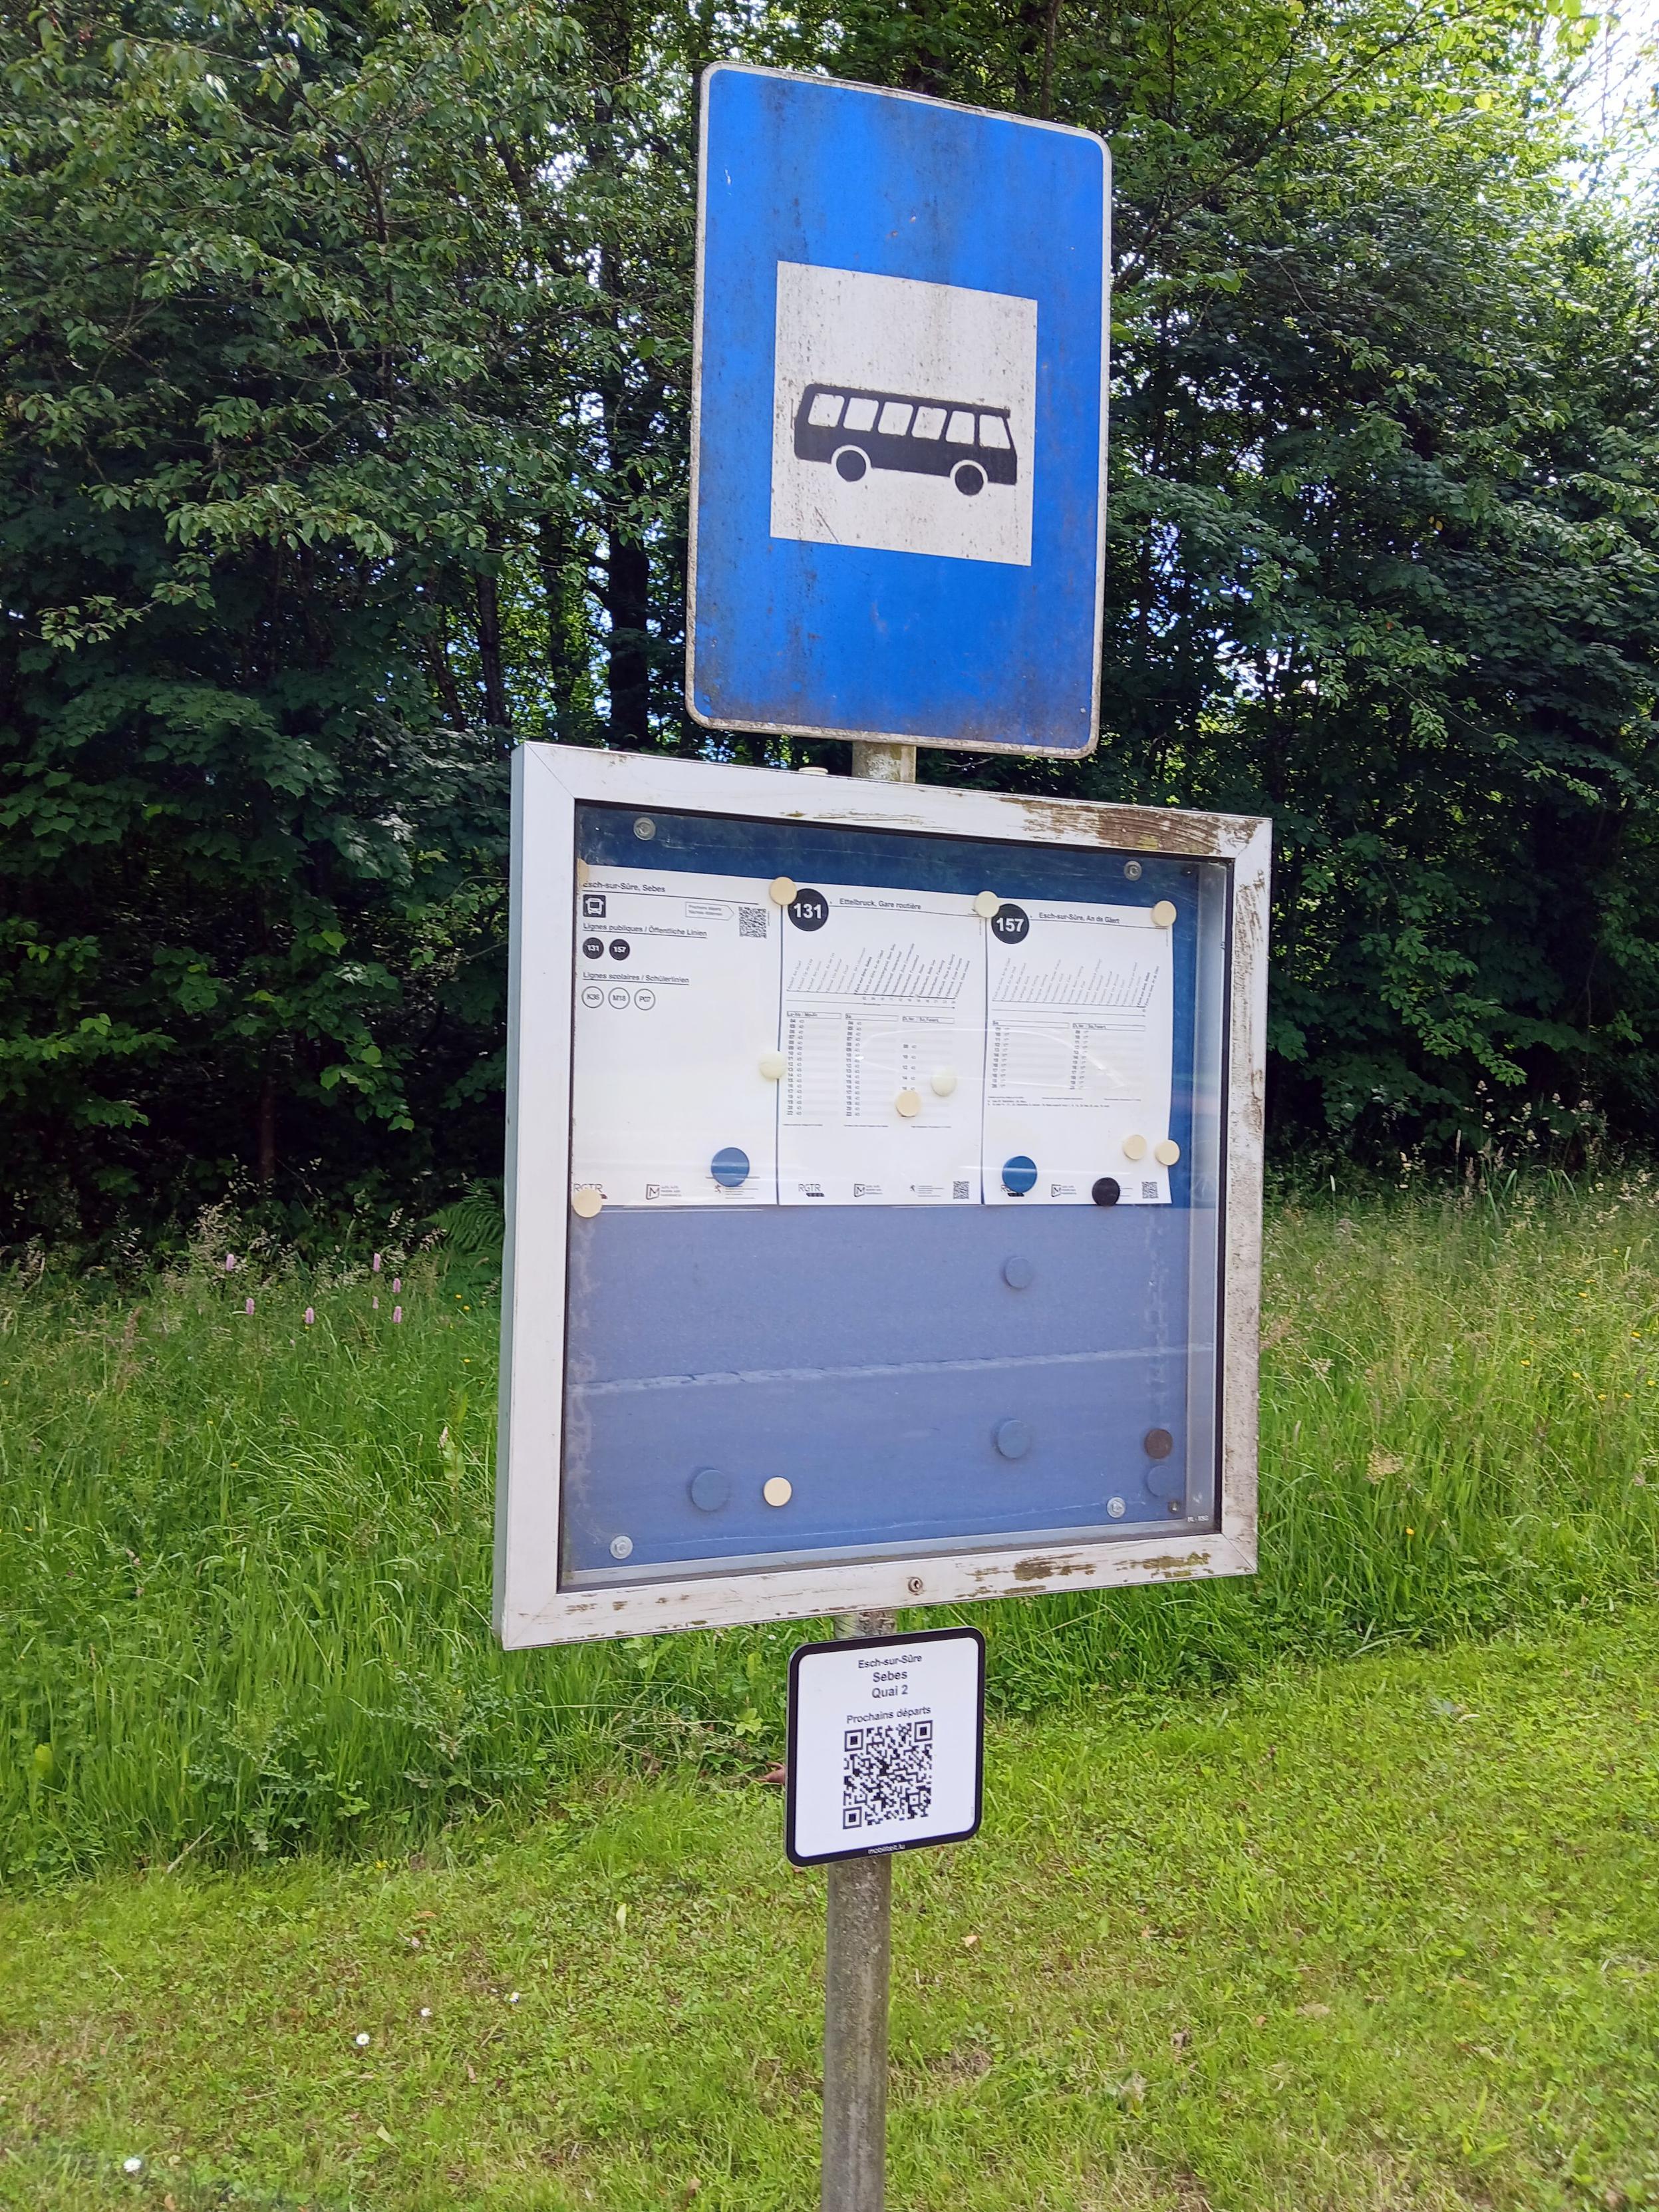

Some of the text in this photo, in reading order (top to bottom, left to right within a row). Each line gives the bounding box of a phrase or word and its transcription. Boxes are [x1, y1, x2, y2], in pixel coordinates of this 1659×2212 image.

[793, 903, 822, 919] 131
[583, 923, 607, 931] Lignes
[996, 917, 1024, 933] 157
[583, 972, 607, 981] Lignes
[857, 1654, 923, 1668] Esch-sur-Sûre
[872, 1670, 908, 1682] Sebes
[871, 1684, 909, 1698] Quai 2
[846, 1706, 931, 1724] Prochains départs
